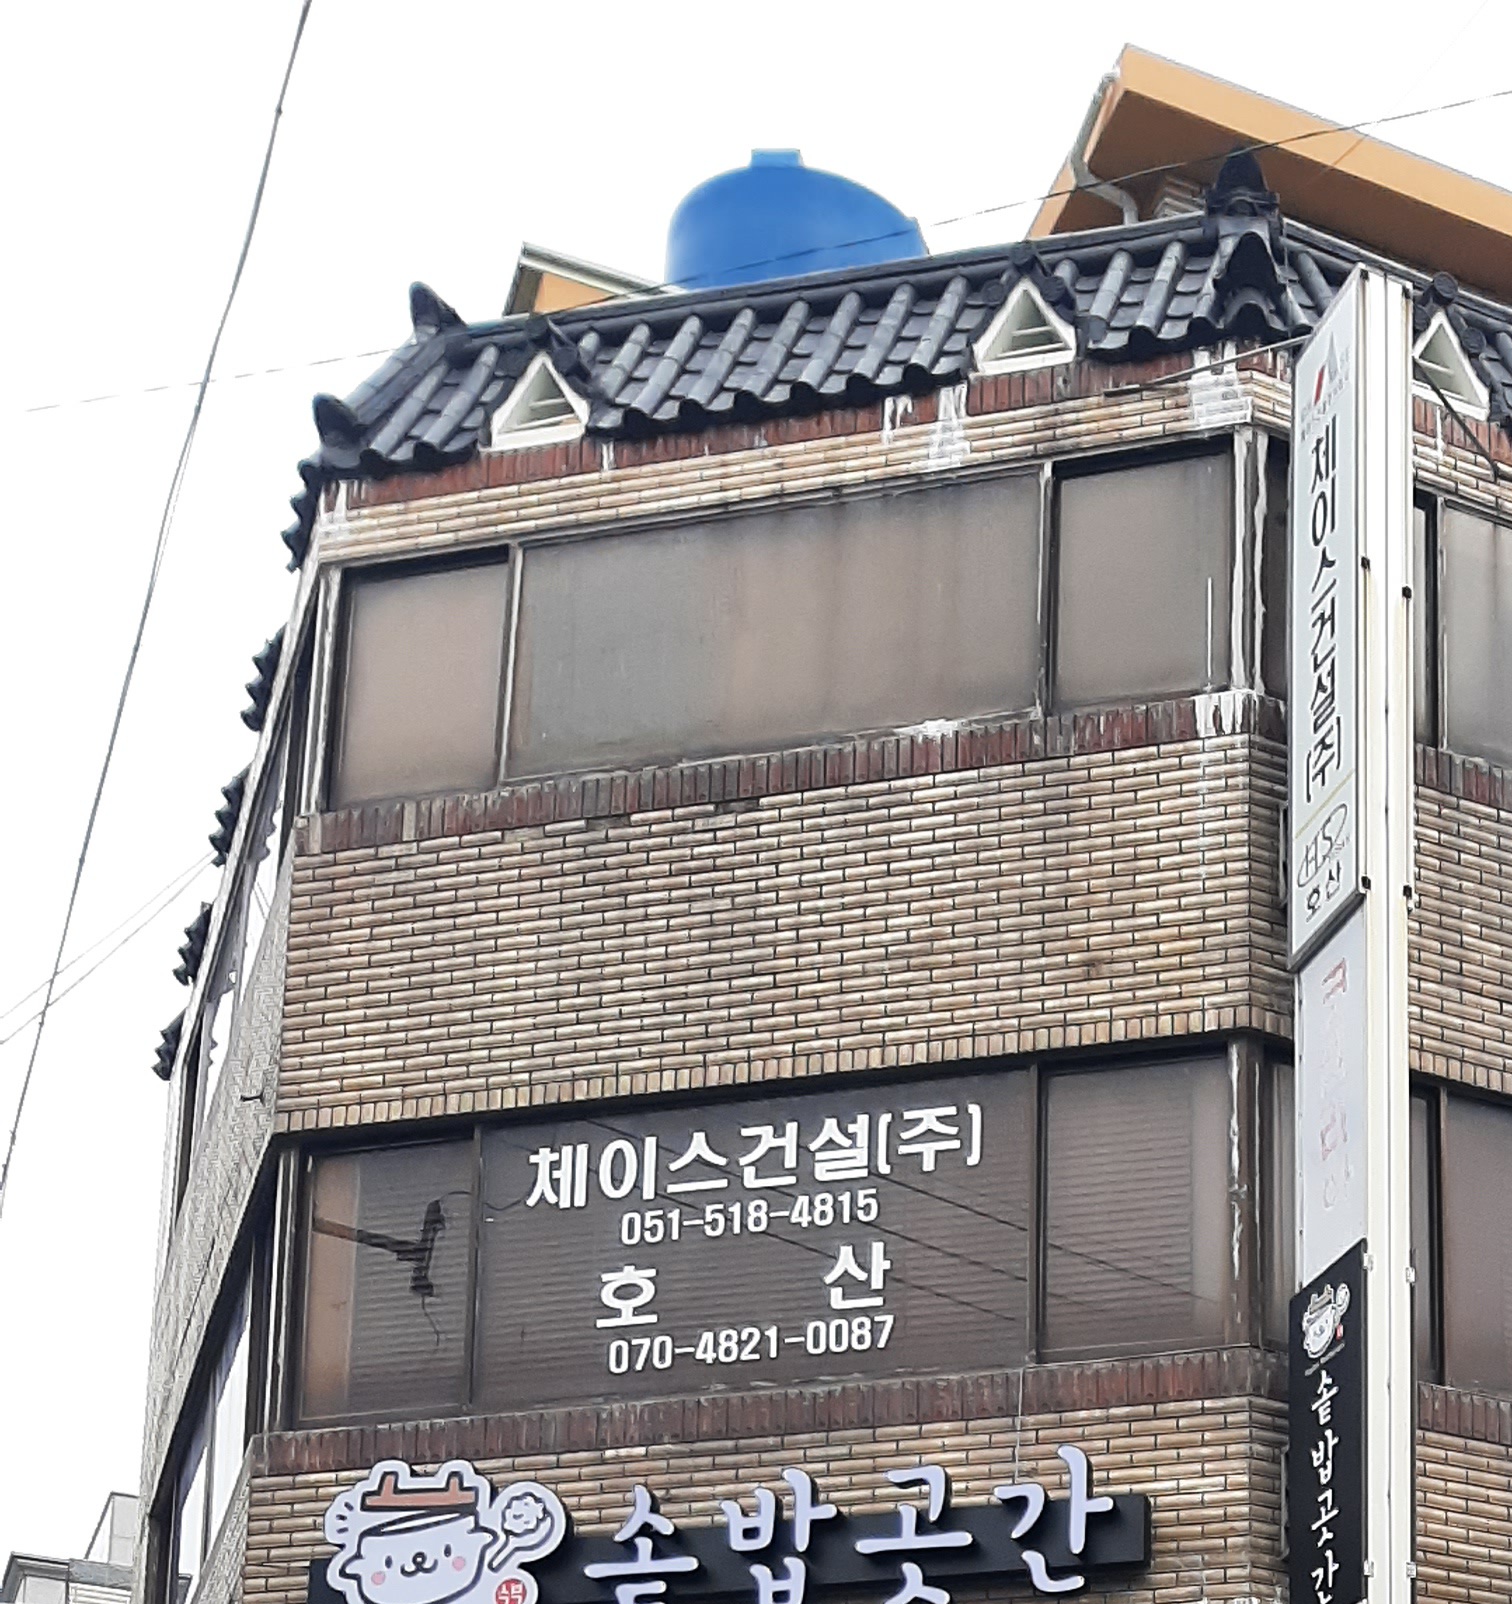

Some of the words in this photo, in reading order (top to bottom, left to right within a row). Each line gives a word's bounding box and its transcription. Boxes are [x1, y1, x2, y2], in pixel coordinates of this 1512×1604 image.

[526, 1102, 983, 1208] 체이스건설(주)
[620, 1189, 880, 1245] 051-518-4815
[607, 1315, 895, 1375] 070-4821-0087
